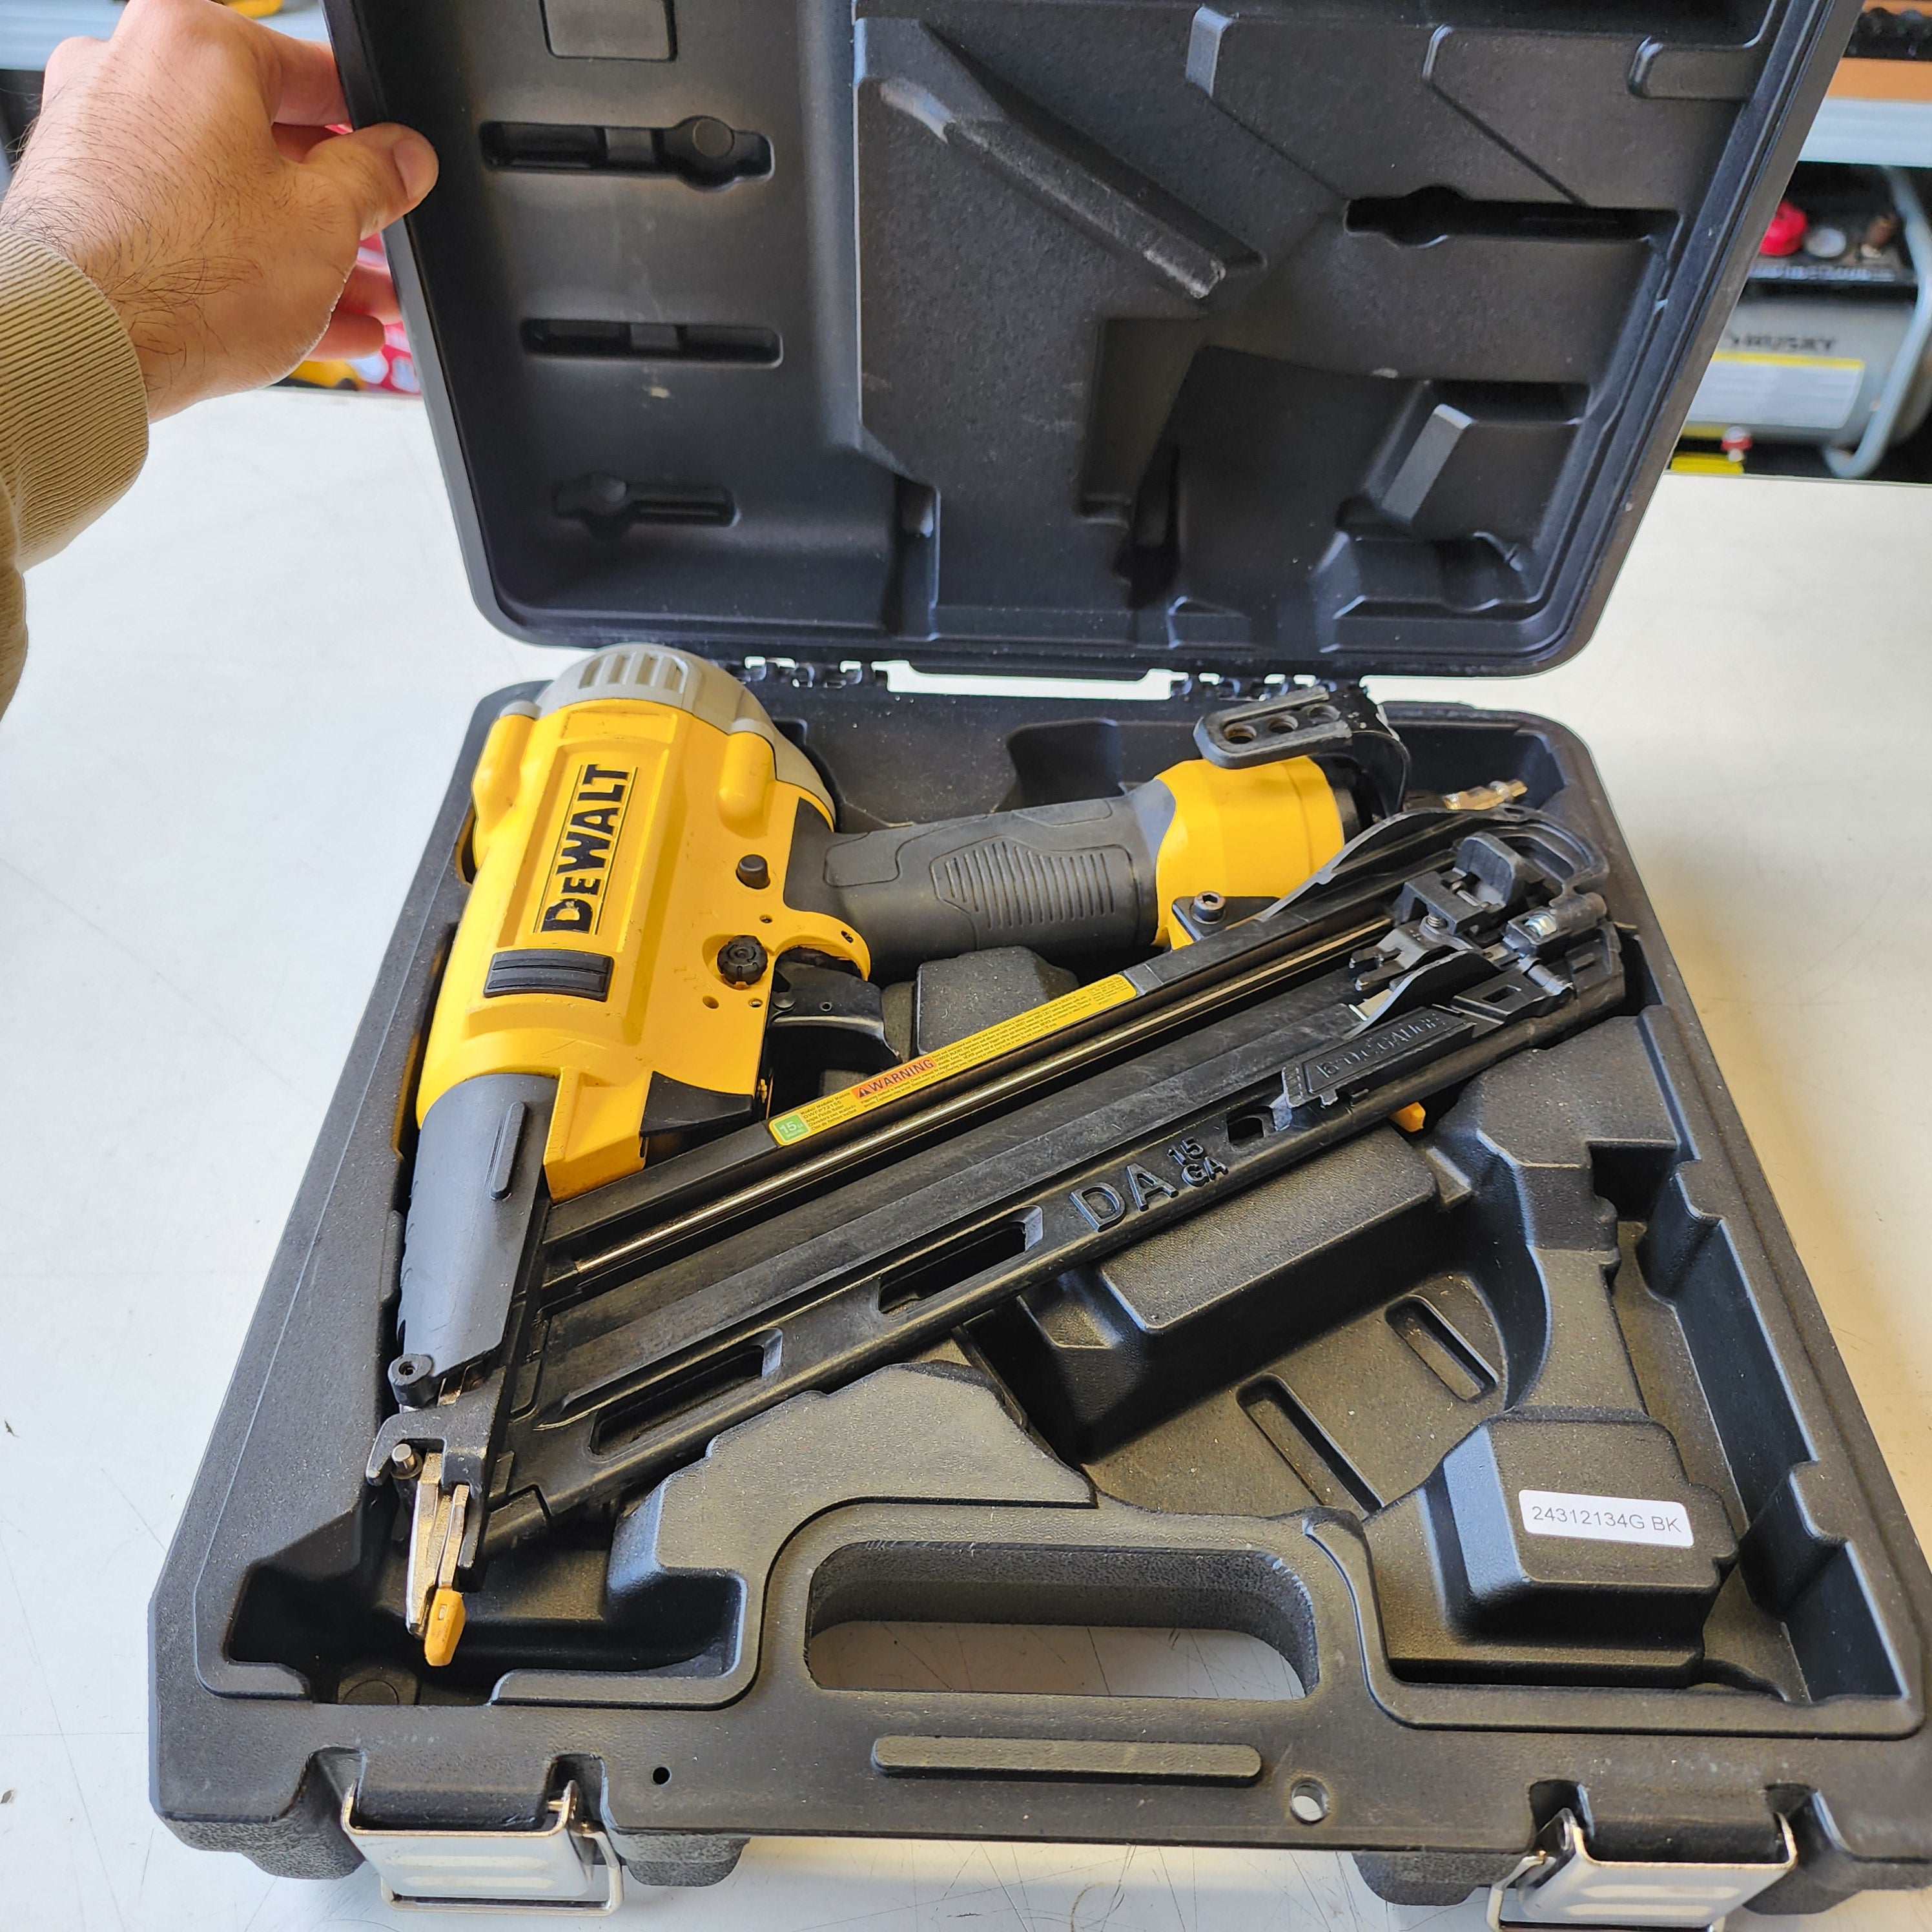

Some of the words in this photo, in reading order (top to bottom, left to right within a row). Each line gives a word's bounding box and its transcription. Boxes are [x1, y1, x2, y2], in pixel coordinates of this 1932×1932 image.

[541, 764, 630, 934] DEWALT
[867, 1059, 934, 1092] WARNING
[779, 1120, 797, 1134] 15
[1167, 1136, 1205, 1167] 15
[1181, 1155, 1229, 1187] GA
[1069, 1162, 1179, 1233] DA
[1531, 1506, 1645, 1530] 24312134G
[1650, 1515, 1683, 1533] BK
